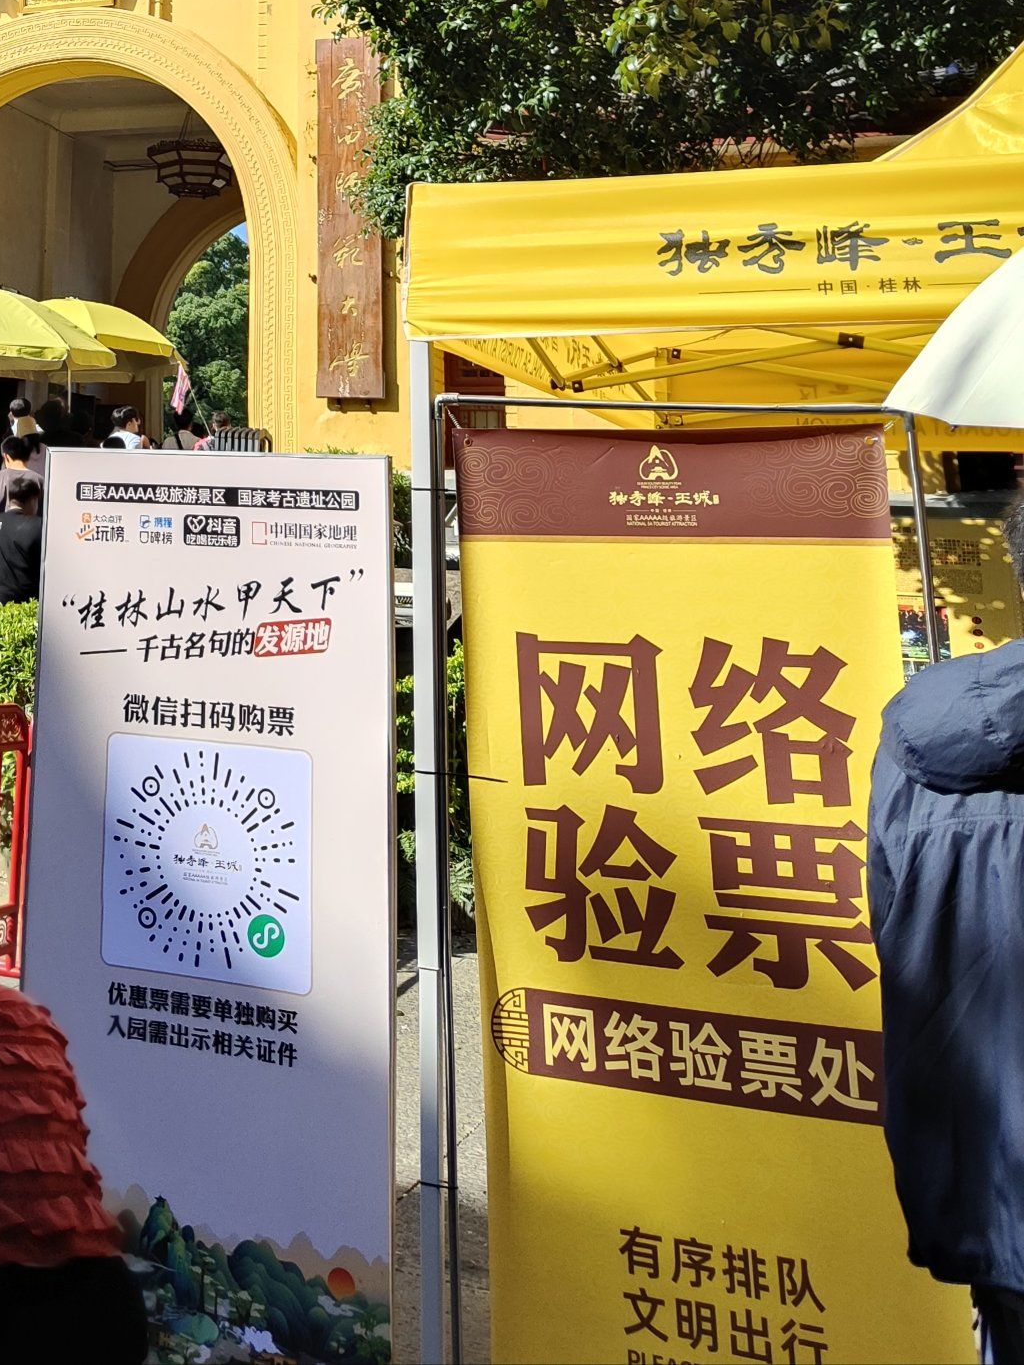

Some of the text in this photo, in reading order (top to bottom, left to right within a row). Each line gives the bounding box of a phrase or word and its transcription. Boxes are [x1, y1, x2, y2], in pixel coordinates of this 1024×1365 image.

[657, 218, 1024, 276] 独秀峰·王
[817, 277, 922, 296] 中国·桂林
[80, 484, 357, 510] 国家AAAAA级旅游景区 国家考古遗址公园
[93, 515, 123, 523] 大众点评
[140, 531, 173, 545] 口碑榜
[154, 517, 173, 528] 携程
[186, 534, 238, 547] 吃喝玩乐榜
[207, 517, 237, 534] 抖音
[270, 522, 357, 541] 中国国家地理
[123, 693, 295, 736] 微信扫码购票
[516, 631, 857, 807] 网络
[524, 804, 878, 992] 验票
[108, 981, 299, 1034] 优惠票需要单独购买
[107, 1015, 299, 1068] 入园需出示相关证件
[543, 1003, 878, 1112] 网络验票处
[618, 1225, 827, 1314] 有序排队
[622, 1287, 829, 1365] 文明出行
